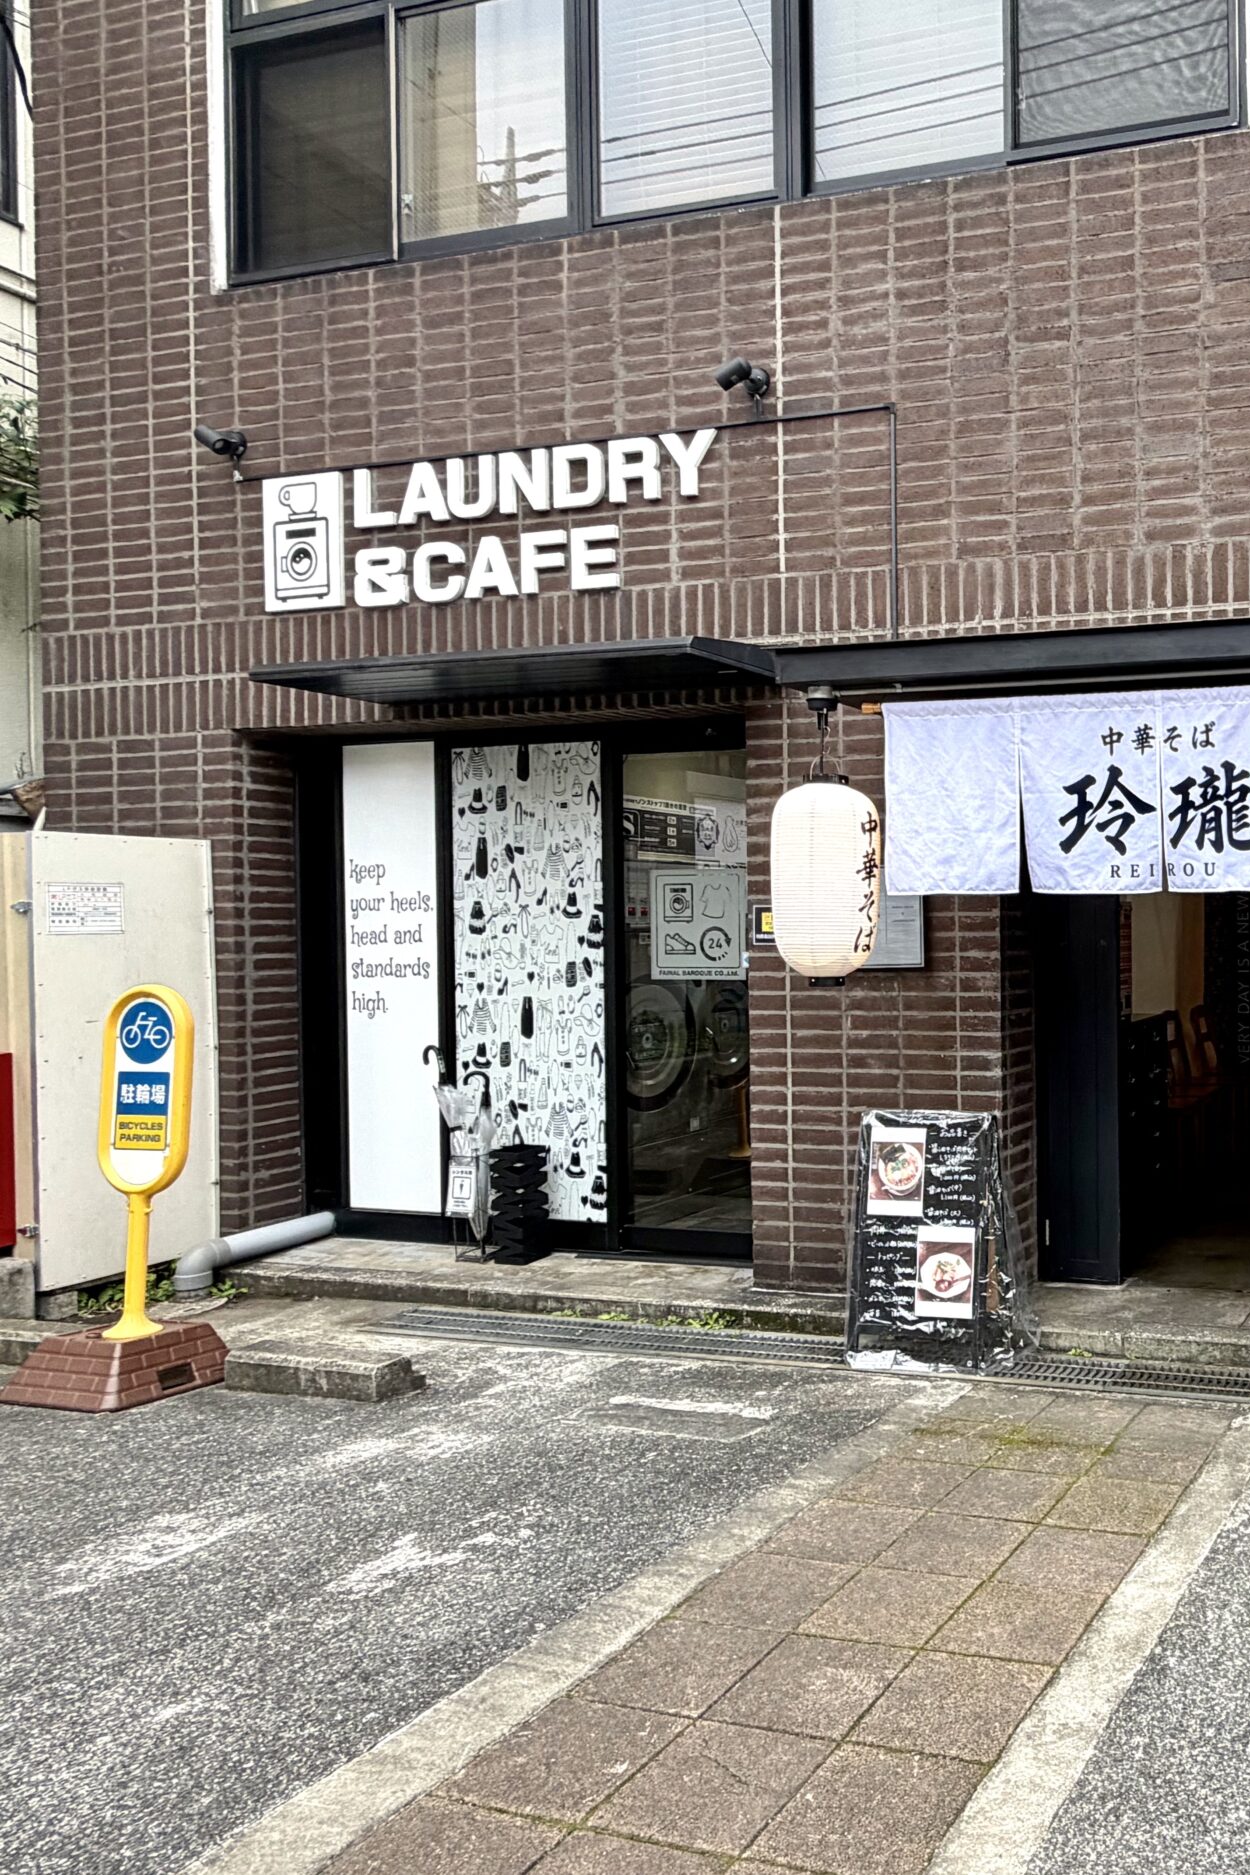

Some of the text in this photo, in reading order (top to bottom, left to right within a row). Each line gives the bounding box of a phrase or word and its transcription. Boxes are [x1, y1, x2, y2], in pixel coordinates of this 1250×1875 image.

[353, 428, 718, 529] LAUNDRY
[354, 524, 621, 607] &CAFE
[1101, 721, 1216, 757] 中華そば
[349, 859, 386, 885] keep
[1110, 862, 1217, 878] REIROU
[854, 811, 879, 953] 中華そば
[350, 897, 385, 920] your
[1237, 895, 1250, 933] NEW
[351, 924, 423, 947] head and
[708, 938, 723, 950] 24
[1237, 940, 1250, 952] A
[351, 957, 431, 980] standards
[1238, 957, 1250, 973] IS
[352, 991, 389, 1019] high.
[1238, 982, 1250, 1014] DAY
[120, 1083, 166, 1105] 駐輪場
[118, 1121, 163, 1131] BICYCLES
[119, 1133, 161, 1143] PARKING
